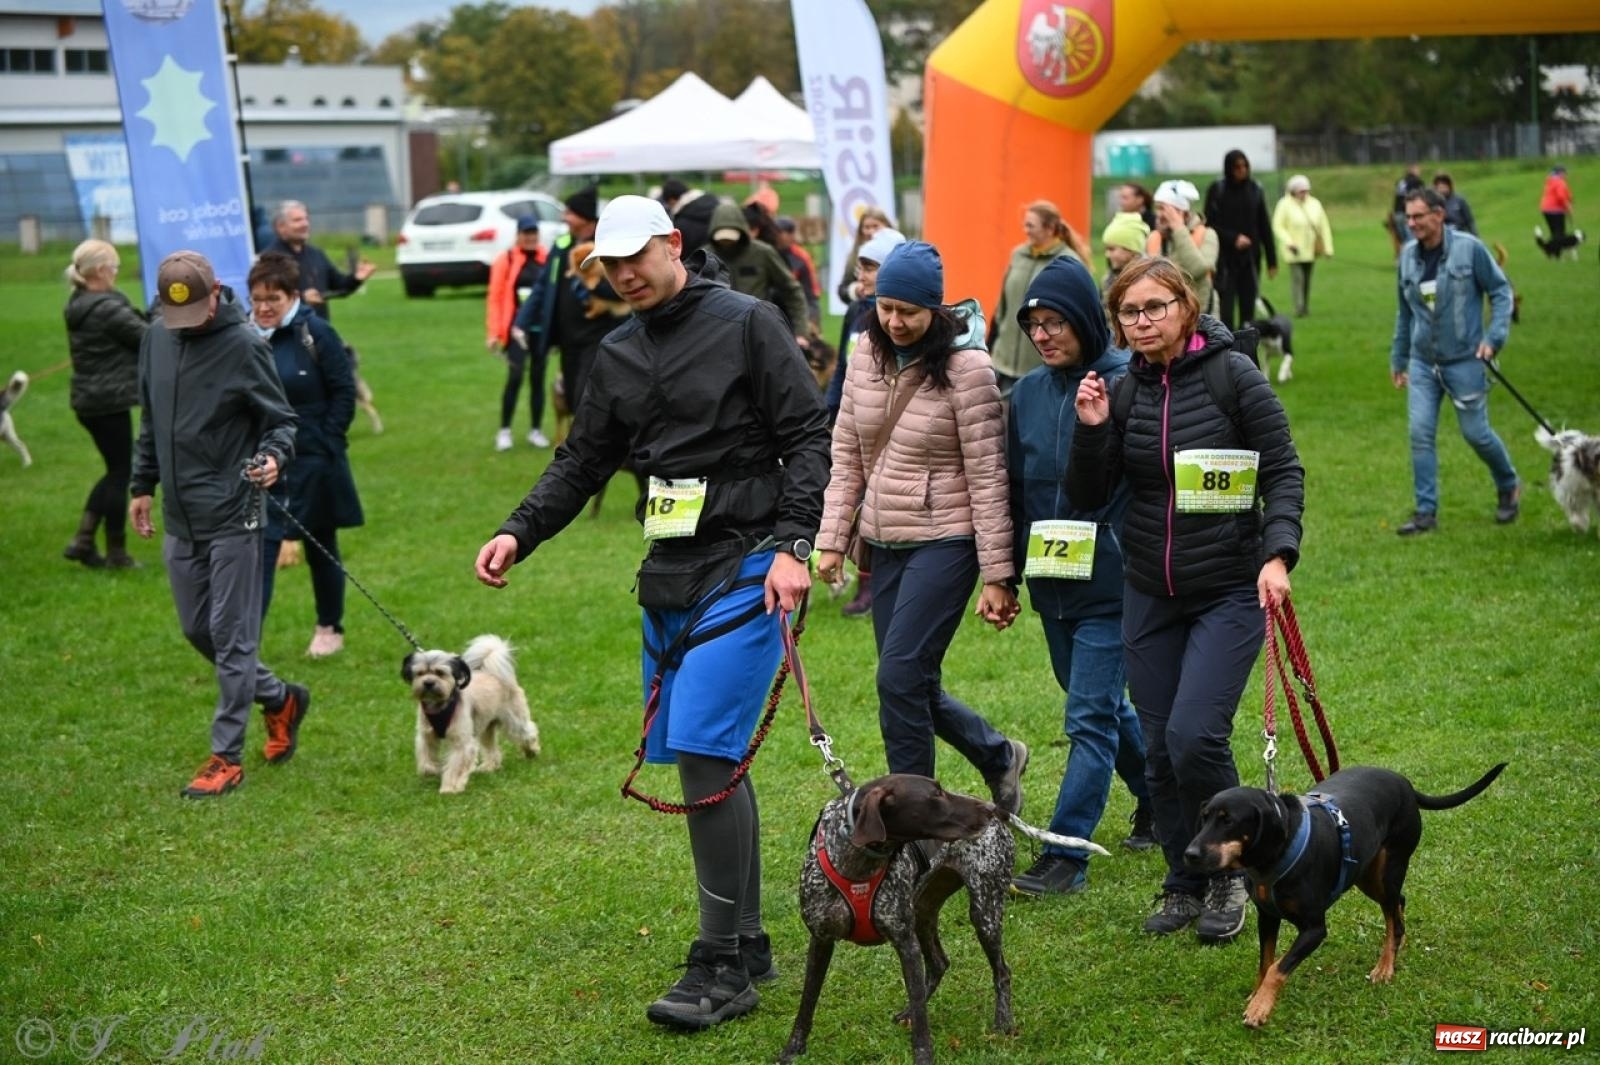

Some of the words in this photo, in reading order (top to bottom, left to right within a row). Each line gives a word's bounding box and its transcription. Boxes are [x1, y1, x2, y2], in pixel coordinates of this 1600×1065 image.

[1202, 471, 1231, 490] 88
[648, 496, 676, 516] 18
[1043, 539, 1069, 558] 72
